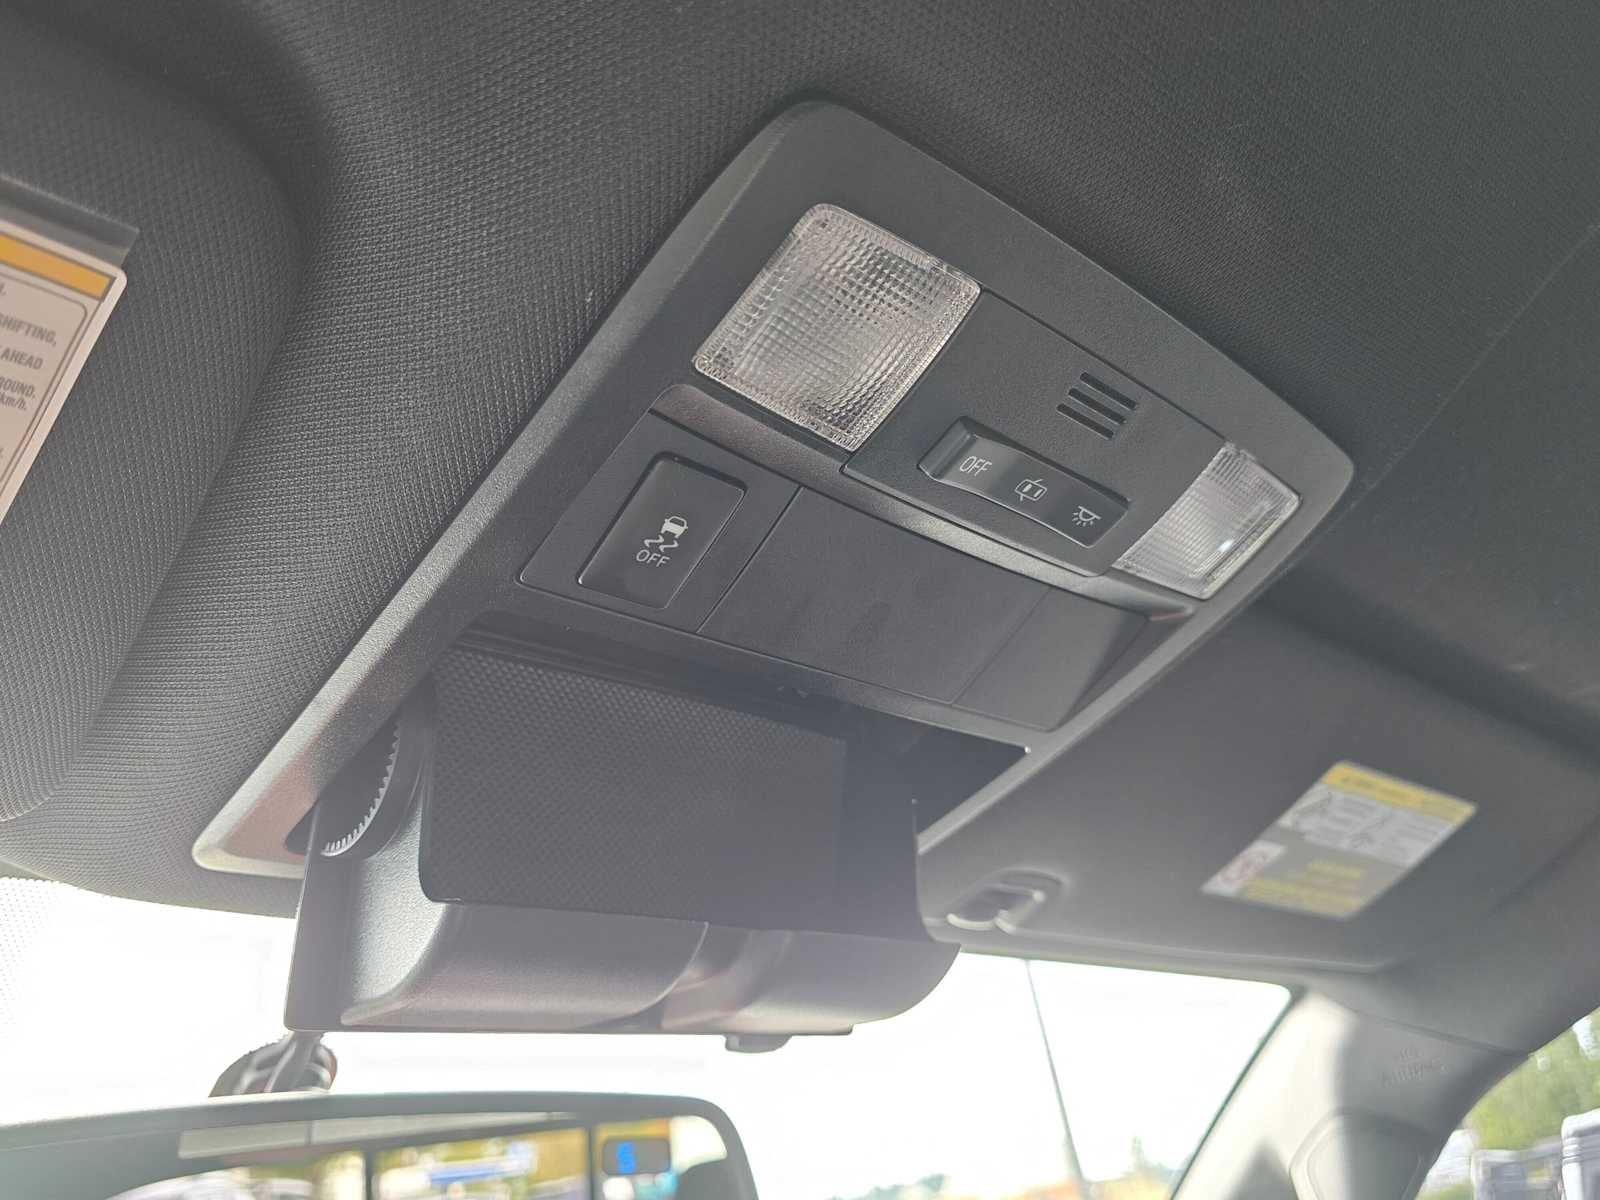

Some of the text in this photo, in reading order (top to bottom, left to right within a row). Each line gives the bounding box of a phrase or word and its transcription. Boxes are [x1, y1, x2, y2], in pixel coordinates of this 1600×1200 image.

[0, 347, 43, 370] AHEAD
[960, 455, 993, 477] OFF
[635, 549, 670, 567] OFF
